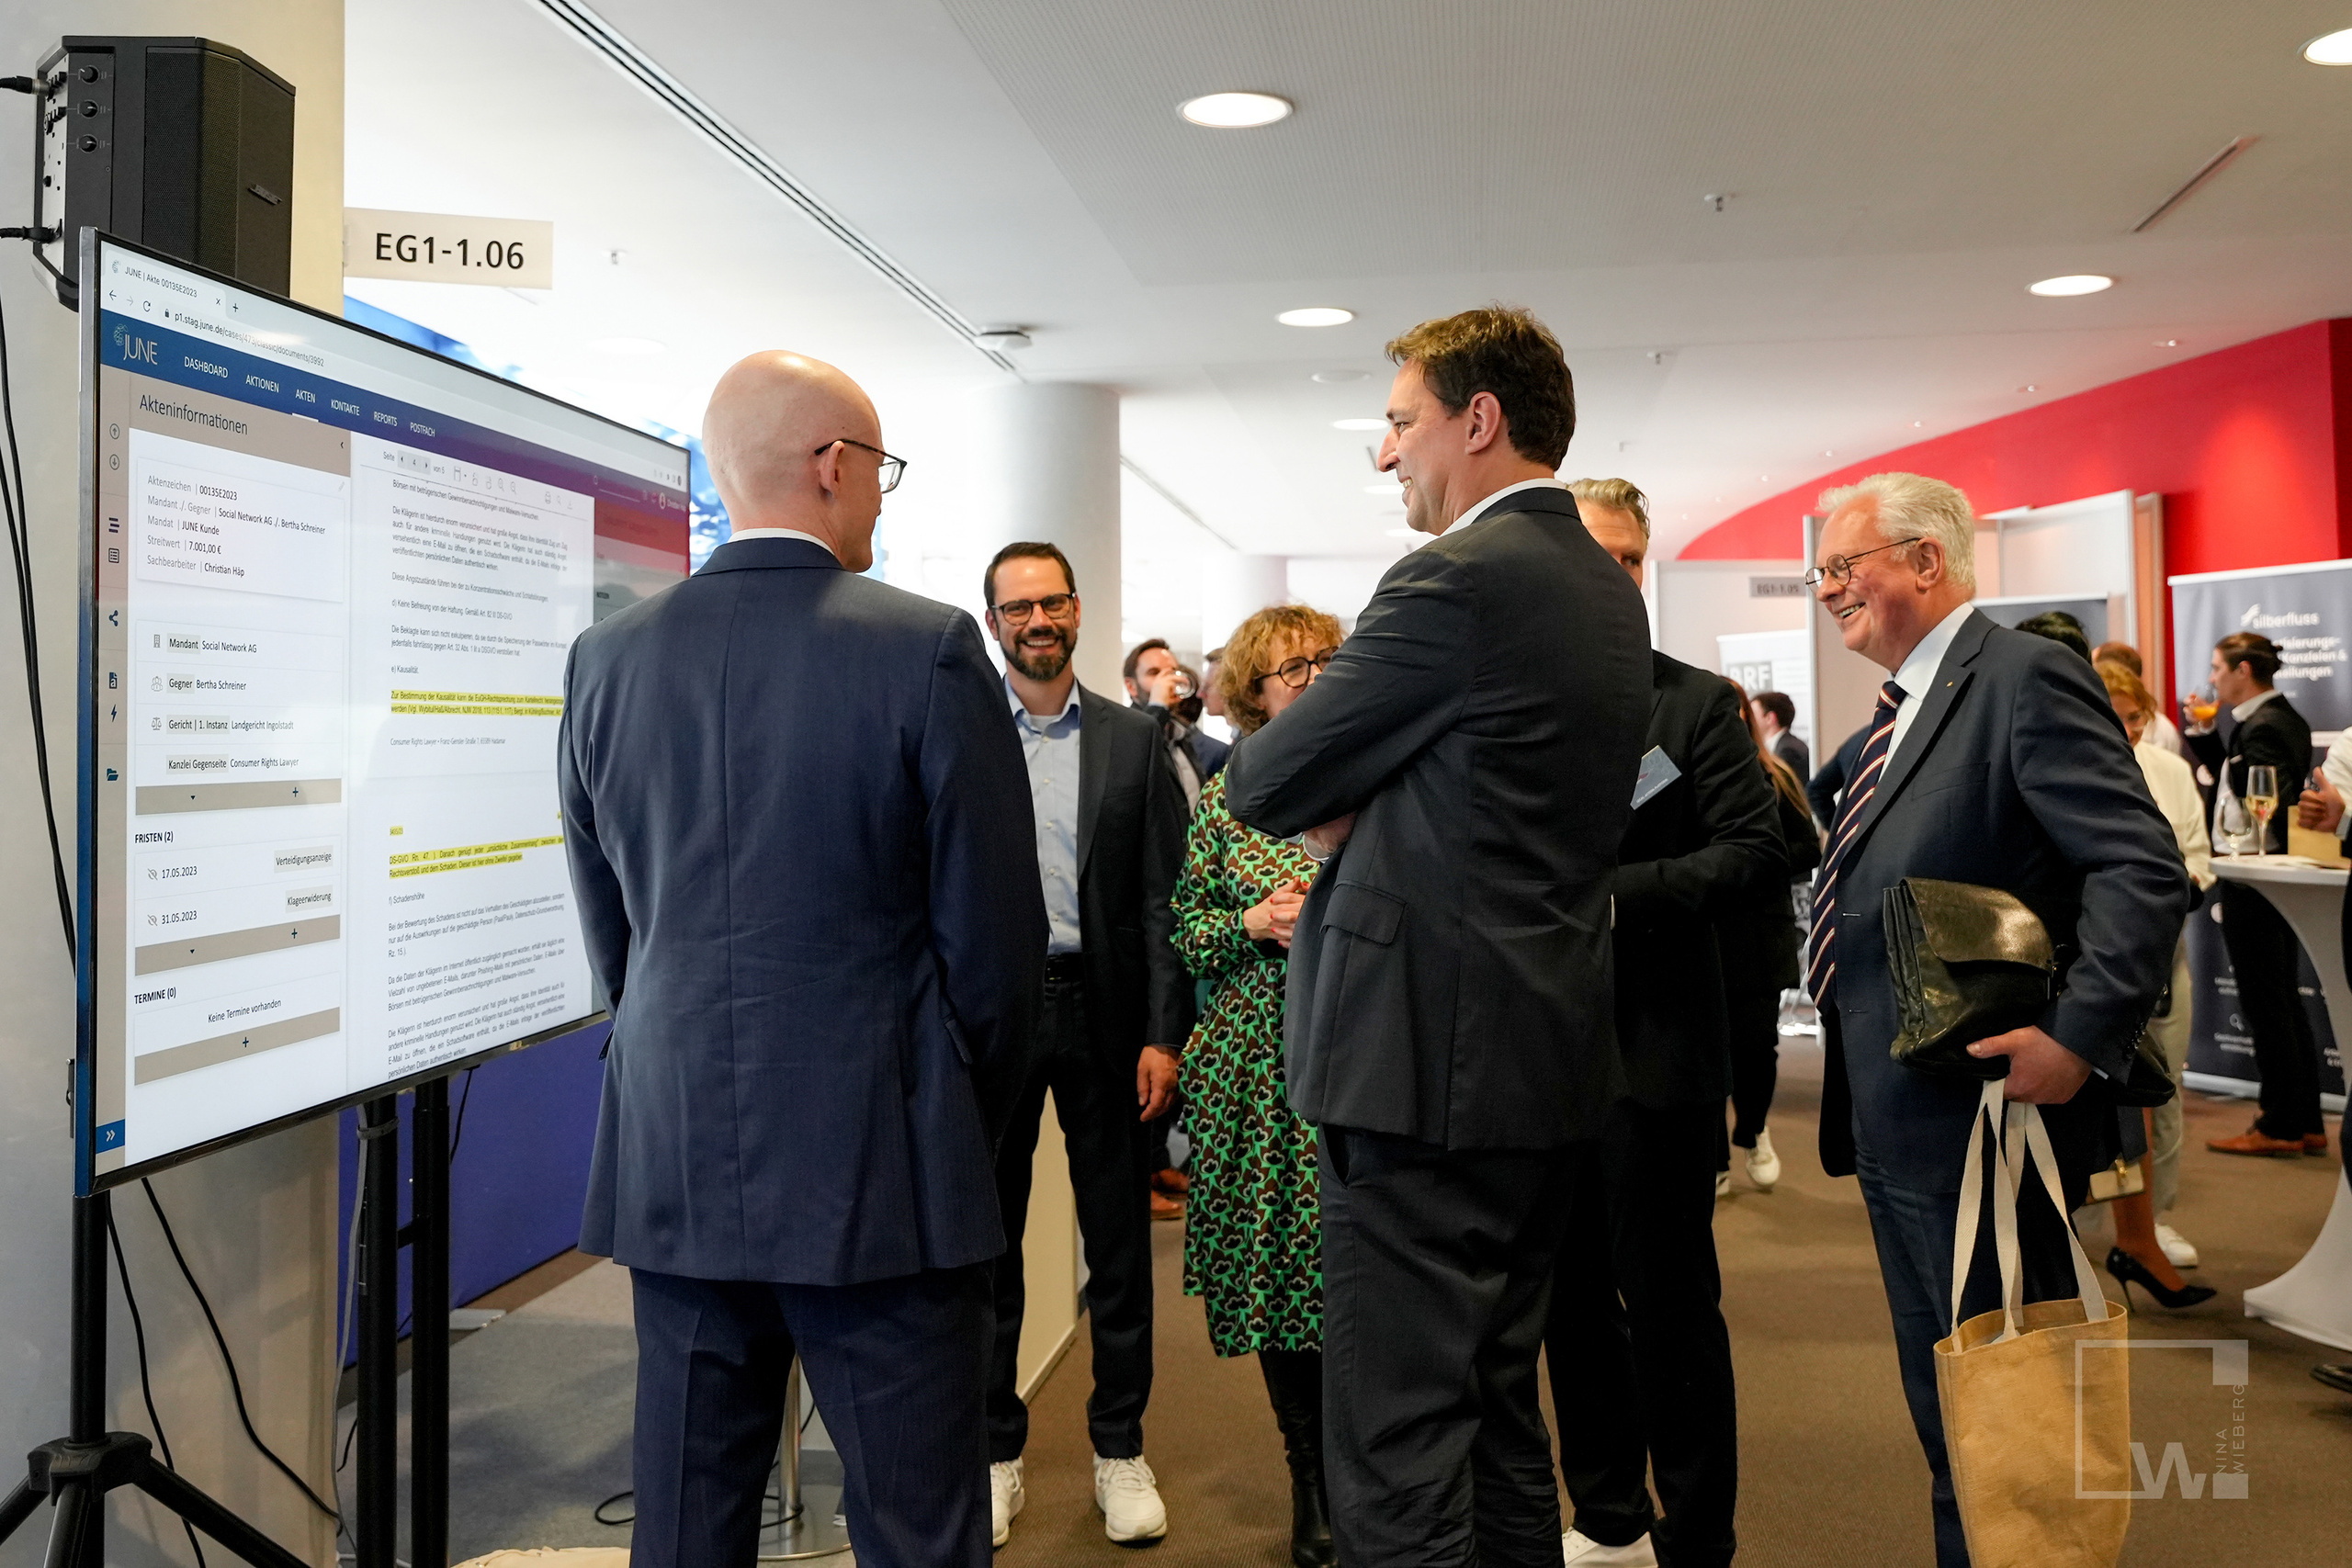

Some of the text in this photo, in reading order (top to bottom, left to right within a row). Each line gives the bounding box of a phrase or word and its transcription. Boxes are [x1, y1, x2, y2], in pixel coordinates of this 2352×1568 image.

[376, 232, 525, 269] EG1-1.06
[124, 266, 198, 298] JUNE Akte 00135E2023
[123, 333, 158, 366] JUNE
[184, 356, 435, 437] DASHBOARD AKTIONEN AKTEN KONTAKTE REPORTS POSTFACH
[140, 393, 248, 435] Akteninformationen
[383, 452, 395, 462] Seite
[147, 475, 238, 501] Aktenzeichen 00135E2023
[148, 495, 177, 510] Mandant
[187, 502, 210, 517] Gegner
[219, 507, 236, 519] Social
[238, 511, 263, 524] Network
[264, 515, 273, 525] AG
[281, 519, 300, 531] Bertha
[300, 522, 325, 535] Schreiner
[148, 515, 220, 536] Mandat JUNE Kunde
[147, 535, 221, 555] Streitwert 7.001,00 €
[147, 555, 244, 578] Sachbearbeiter Christian Häp
[2252, 612, 2320, 630] silberfluss
[169, 638, 257, 653] Mandant Social Network AG
[169, 678, 246, 690] Gegner Bertha Schreiner
[168, 719, 294, 731] Gericht 1. Instanz Landgericht Ingolstadt
[168, 758, 299, 772] Kanzlei Gegenseite Consumer Rights Lawyer
[134, 831, 174, 844] FRISTEN (2)
[162, 852, 332, 879] 17.05.2023 Verteidigungsanzeige
[161, 892, 332, 925] 31.05.2023 Klageerwiderung
[134, 987, 176, 1004] TERMINE (0)
[208, 999, 281, 1023] Keine Termine vorhanden
